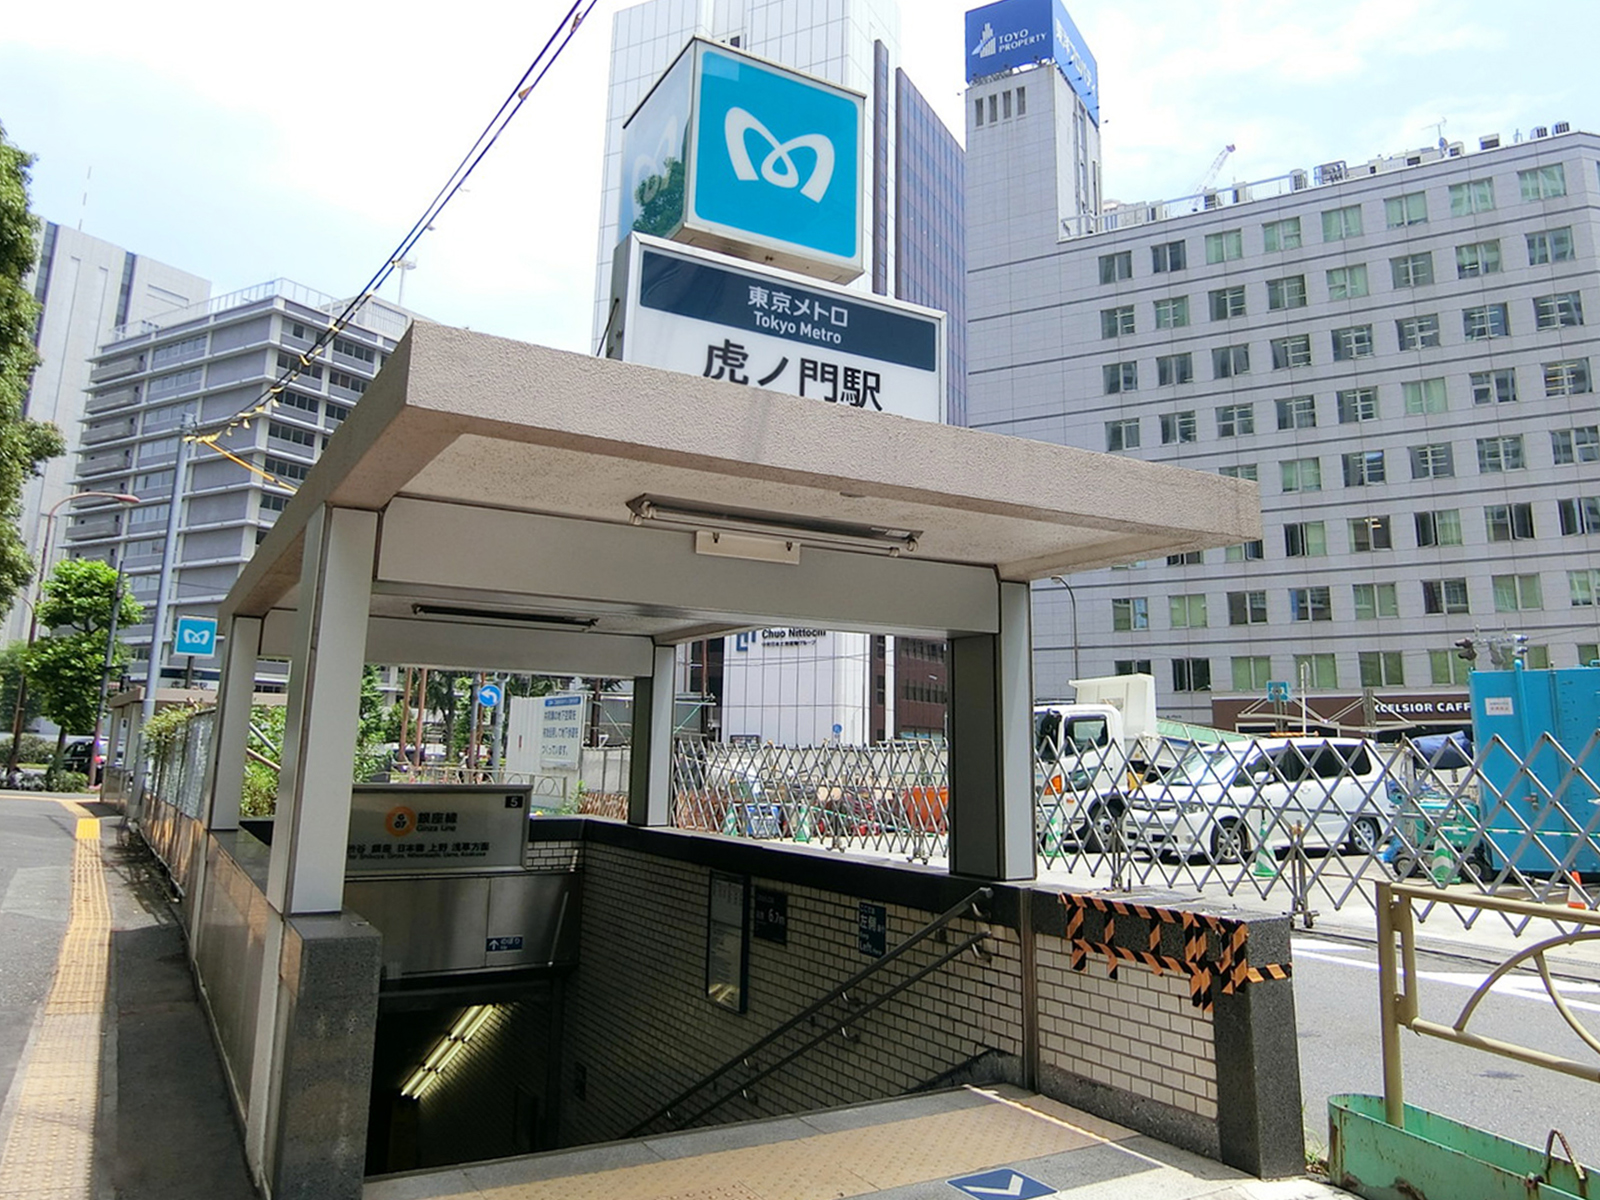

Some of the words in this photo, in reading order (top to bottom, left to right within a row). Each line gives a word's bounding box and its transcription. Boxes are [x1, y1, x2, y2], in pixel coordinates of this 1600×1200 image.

[998, 32, 1048, 53] PROPERTY
[999, 28, 1029, 44] TOYO
[748, 285, 848, 327] 東京メトロ
[753, 311, 796, 335] Tokyo
[800, 322, 842, 344] Metro
[703, 338, 883, 412] 虎ノ門駅
[762, 629, 786, 639] Chuo
[1436, 702, 1471, 712] CAFF
[510, 797, 518, 807] 5
[418, 812, 457, 824] 銀座線
[416, 824, 438, 832] Ginza
[440, 824, 456, 832] Line
